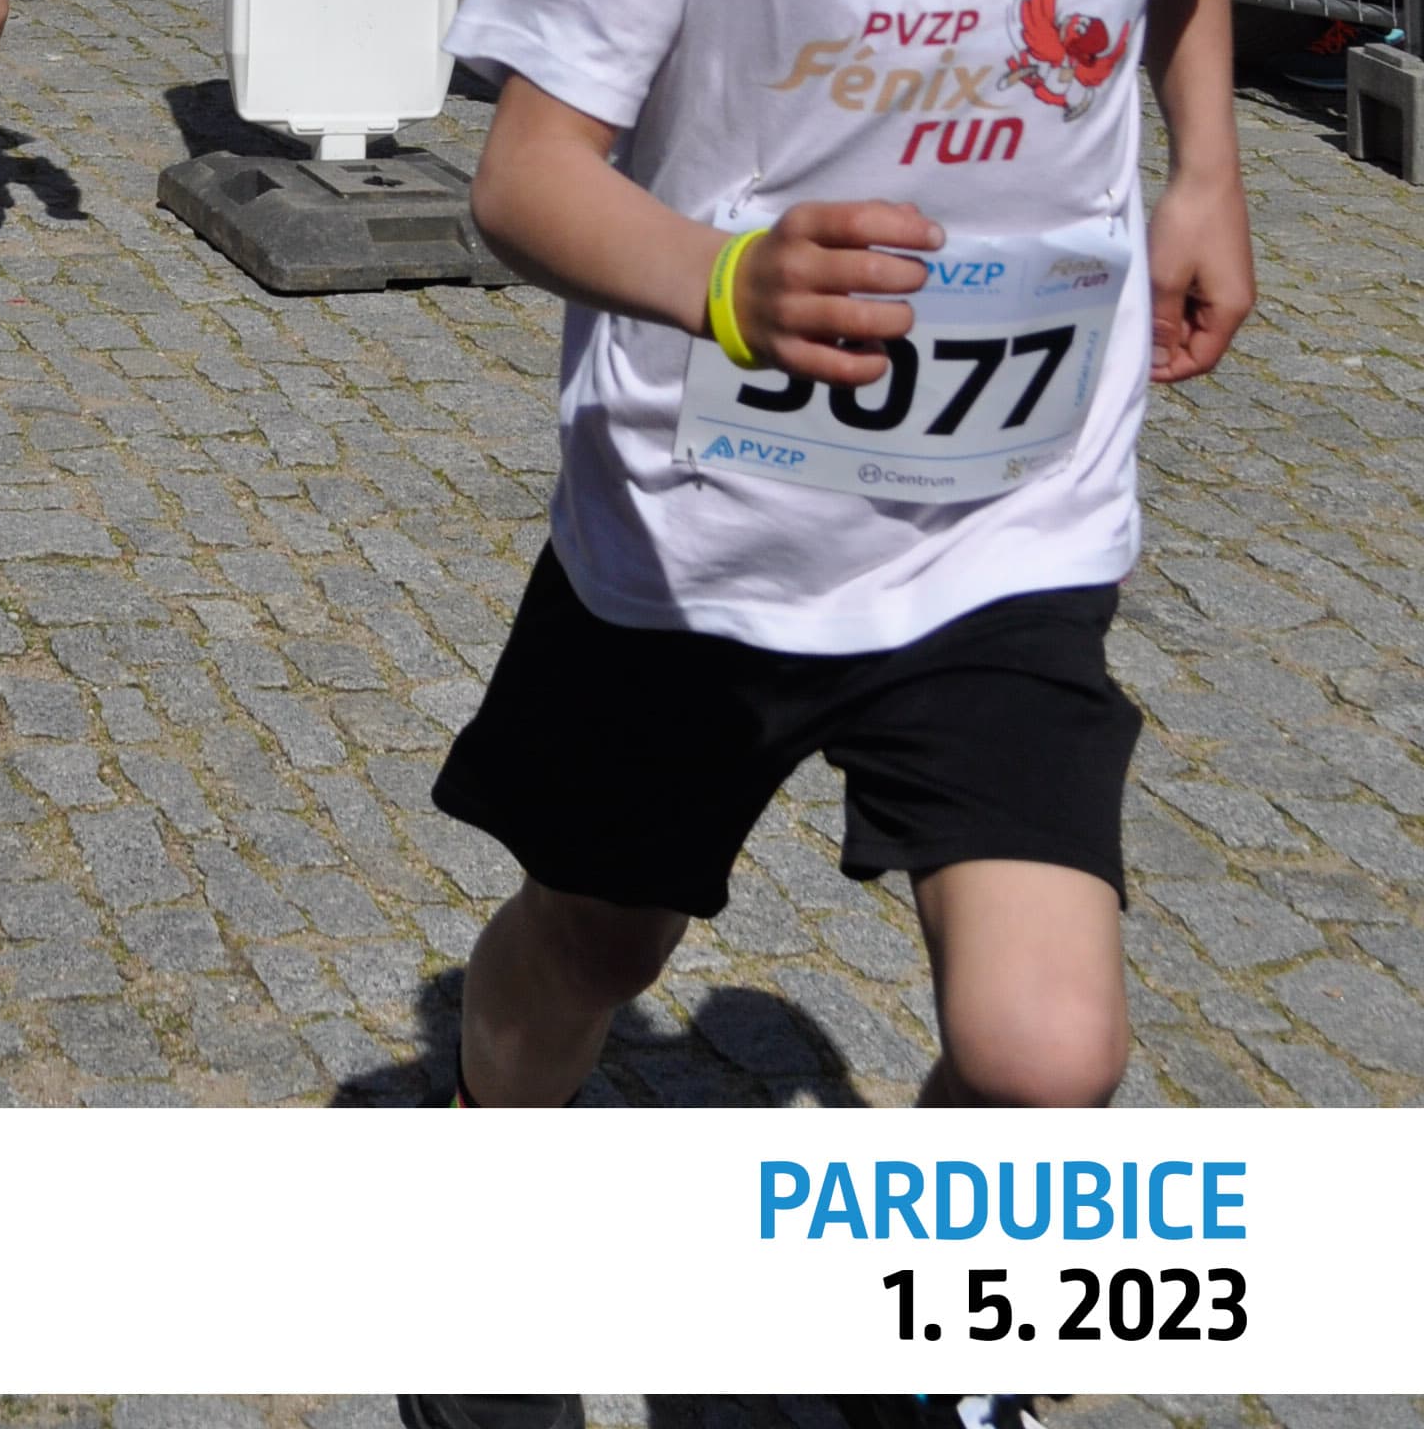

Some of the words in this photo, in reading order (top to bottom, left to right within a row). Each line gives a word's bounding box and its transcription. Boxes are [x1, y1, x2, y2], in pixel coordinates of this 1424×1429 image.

[860, 10, 980, 46] PVZP
[761, 36, 1009, 115] Fénix
[899, 117, 1024, 165] run
[739, 439, 806, 467] PVZP
[884, 471, 955, 488] Centrum
